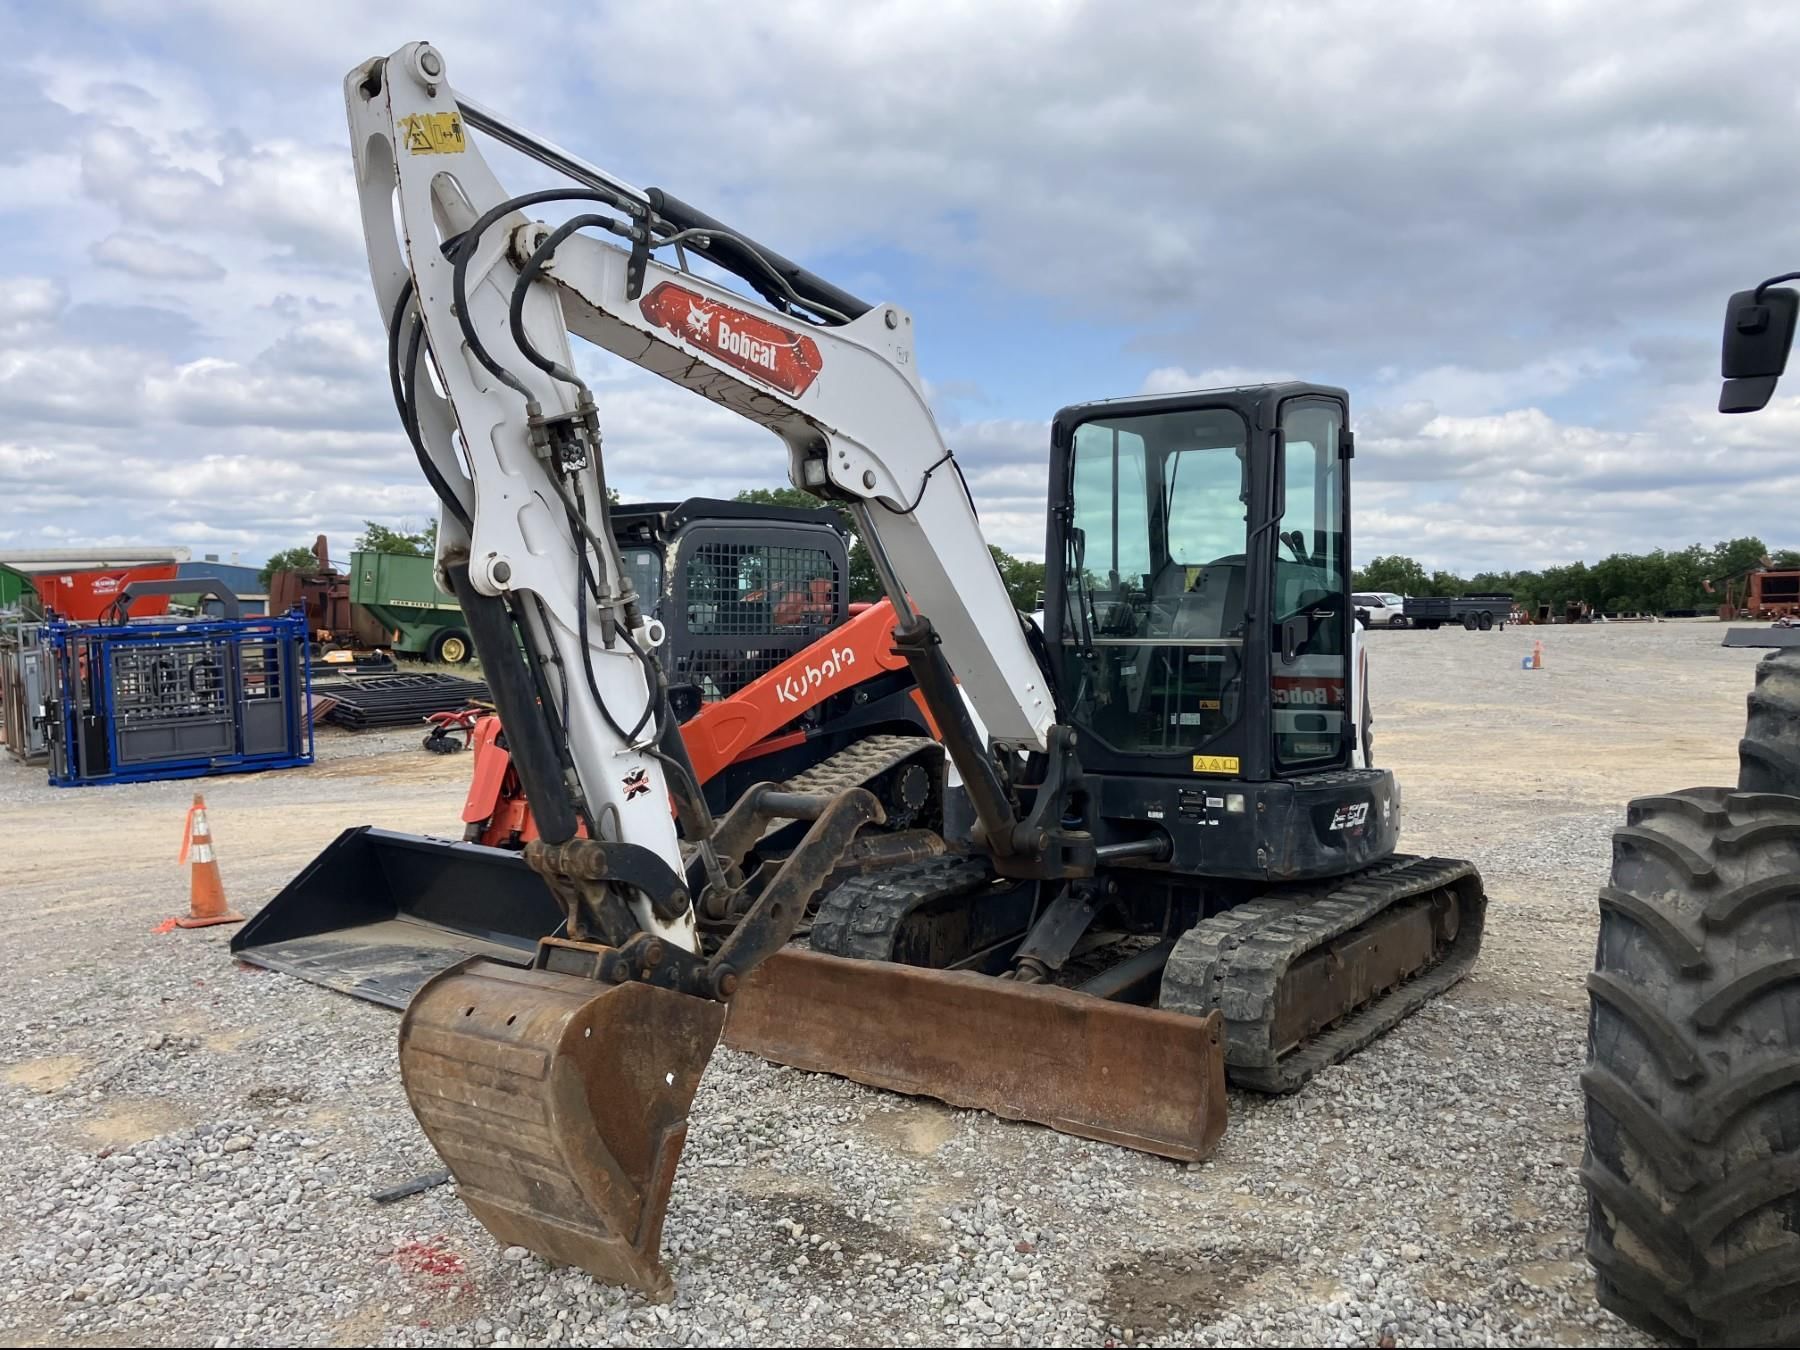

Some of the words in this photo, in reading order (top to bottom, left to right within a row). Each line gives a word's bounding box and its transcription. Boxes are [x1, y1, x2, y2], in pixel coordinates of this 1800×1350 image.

[718, 323, 776, 370] Bobcat
[776, 647, 855, 704] Kubota
[1329, 802, 1369, 830] E50
